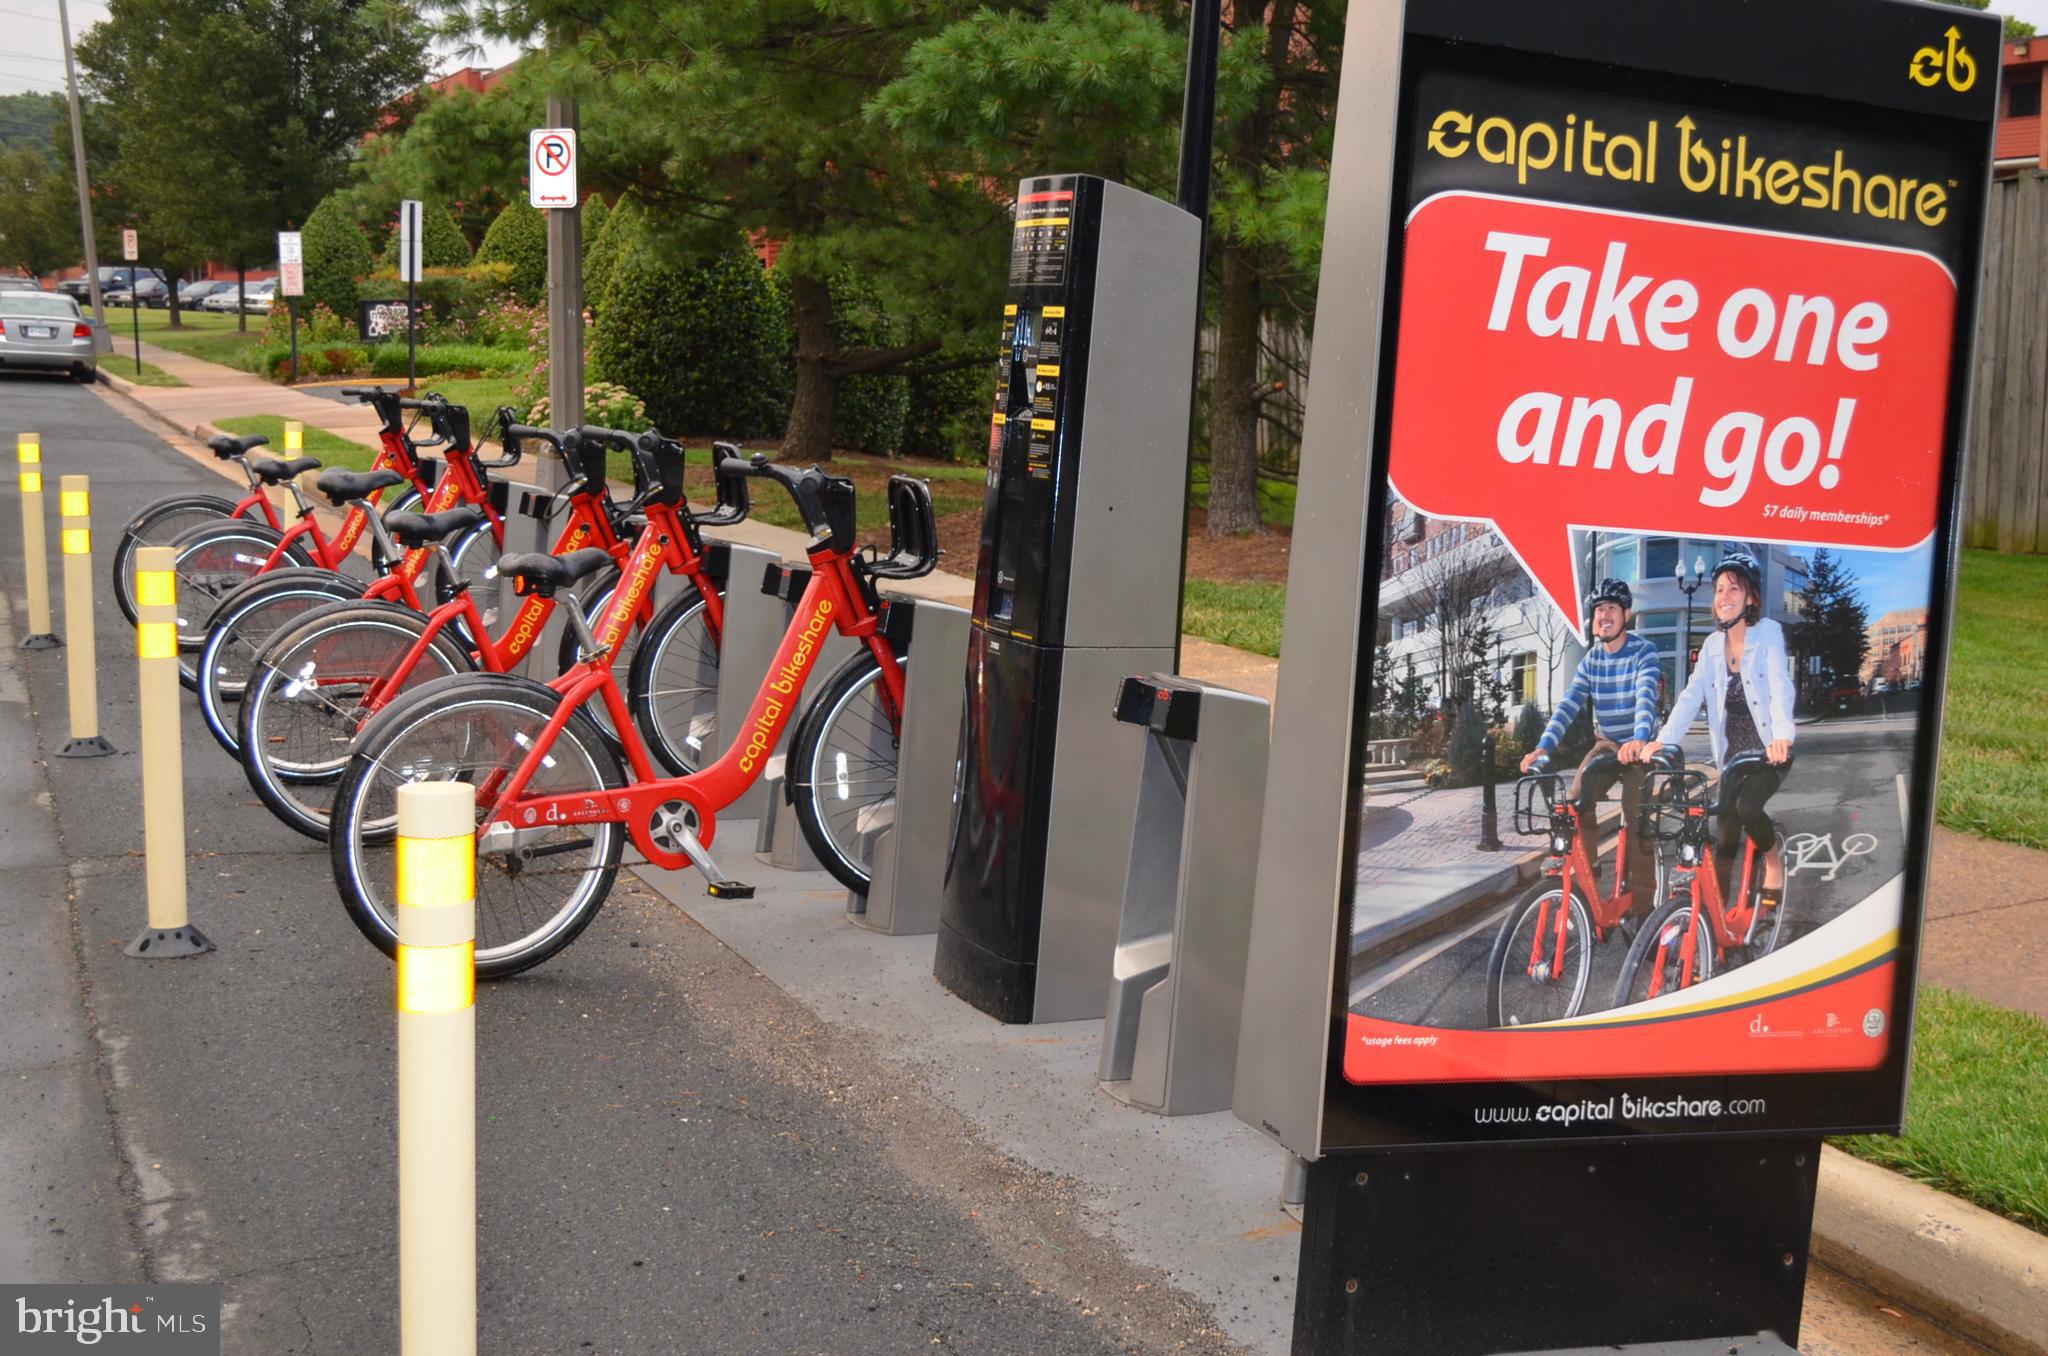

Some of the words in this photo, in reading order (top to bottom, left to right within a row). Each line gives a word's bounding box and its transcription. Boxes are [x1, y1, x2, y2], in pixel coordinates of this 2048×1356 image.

[1427, 110, 1658, 185] capital
[1674, 114, 1948, 227] bikeshare
[1484, 231, 1700, 352] Take
[1716, 287, 1890, 371] one
[1496, 376, 1695, 476] and
[1698, 397, 1857, 508] go!
[1762, 504, 1779, 517] $7
[1779, 505, 1808, 522] daily
[614, 543, 662, 623] bikeshare
[509, 598, 545, 655] capital
[739, 696, 784, 773] capital
[769, 599, 833, 695] bikeshare
[1393, 1034, 1412, 1046] fees
[1412, 1034, 1438, 1047] apply
[1474, 1106, 1532, 1123] www.
[1535, 1097, 1614, 1127] capital
